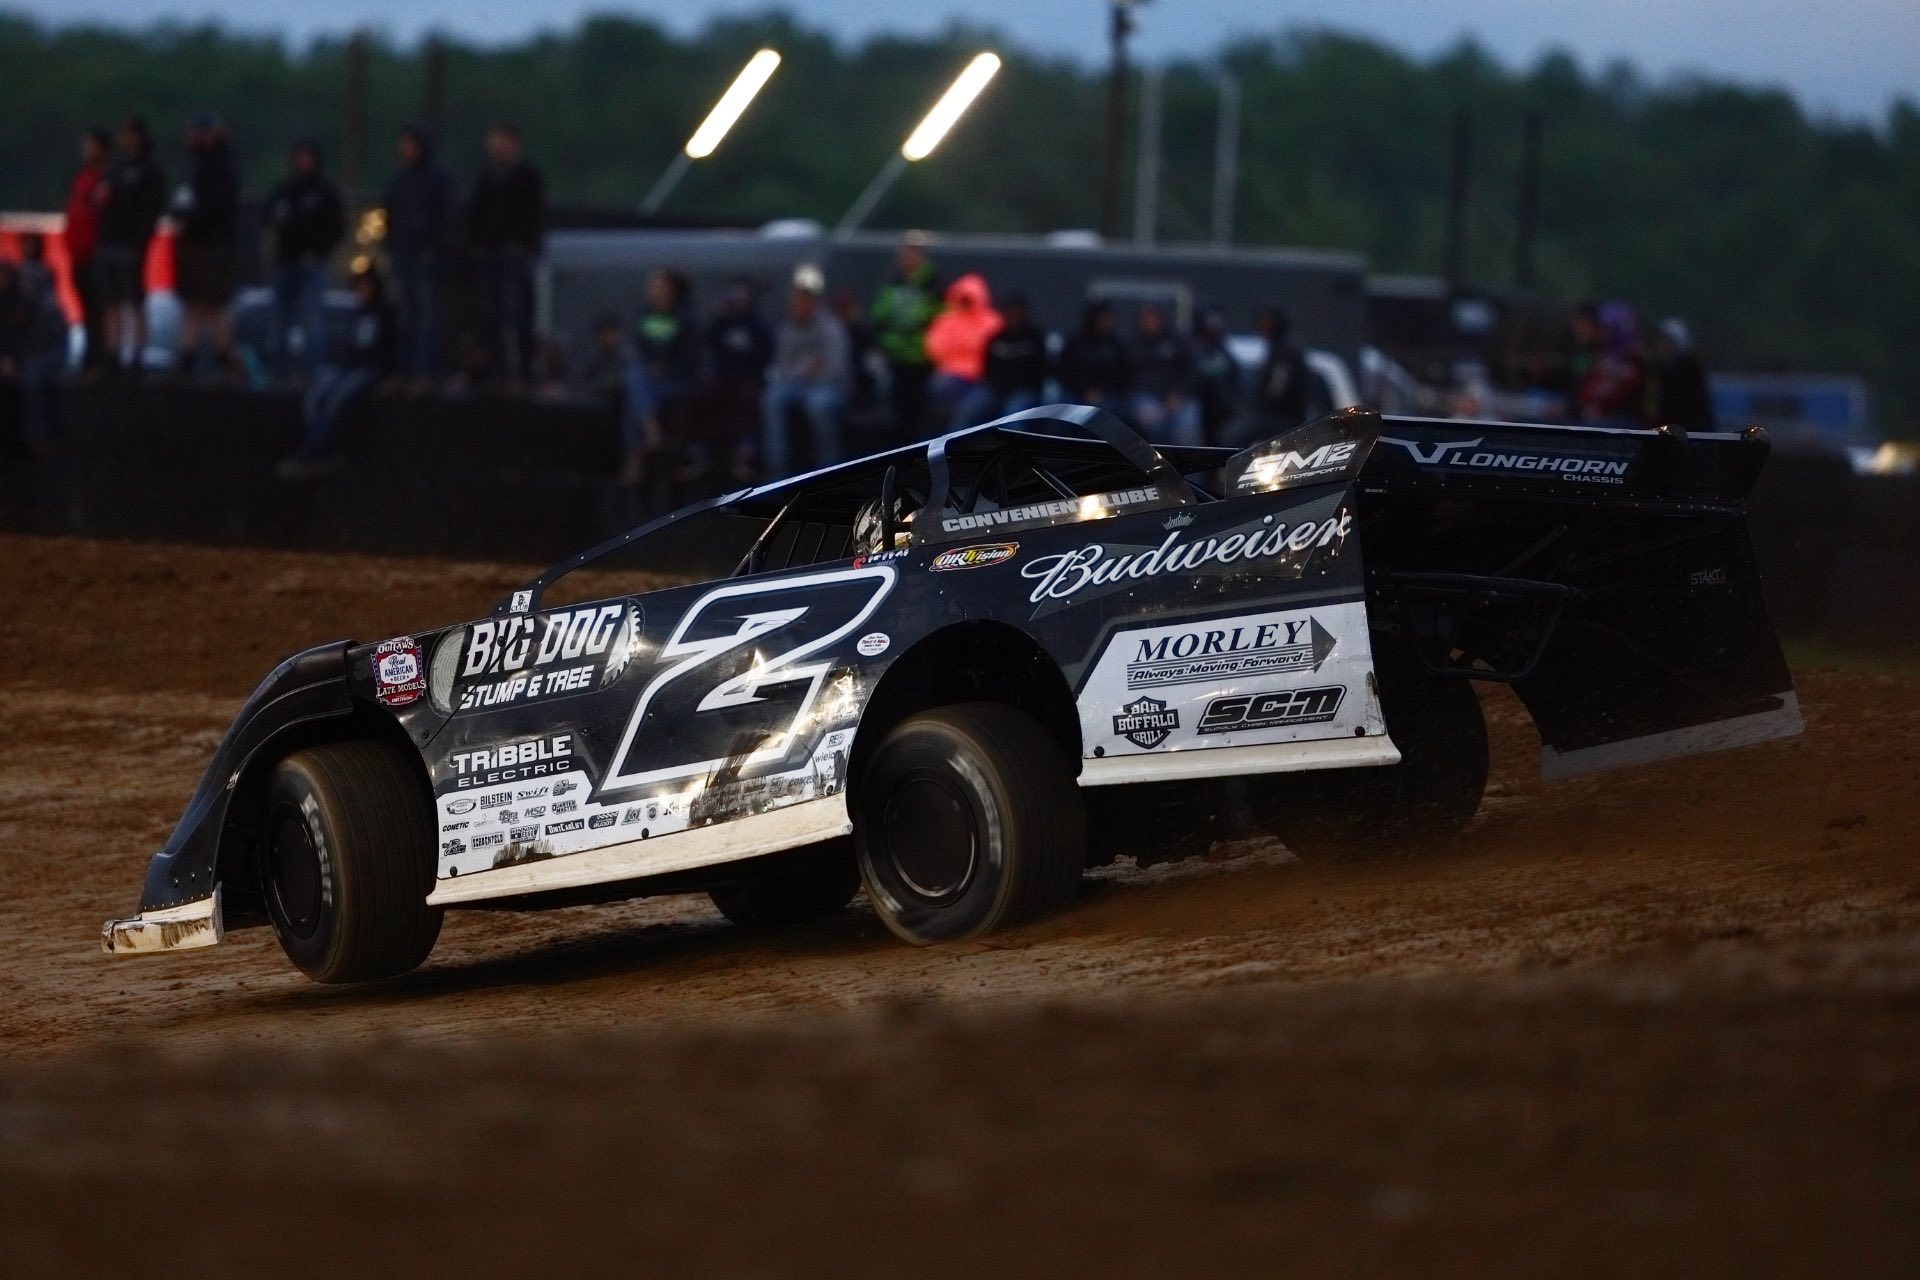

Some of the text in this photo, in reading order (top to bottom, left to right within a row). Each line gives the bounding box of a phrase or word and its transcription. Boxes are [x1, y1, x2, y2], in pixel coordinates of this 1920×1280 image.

[1450, 451, 1629, 475] LONGHORN
[1562, 473, 1624, 484] CHASSIS
[942, 487, 1160, 532] CONVENIEN LUBE
[1020, 514, 1352, 603] Budweiser
[378, 638, 415, 654] OUTLAWS
[461, 604, 622, 677] BIG DOG
[1133, 619, 1309, 663] MORLEY
[388, 654, 407, 668] Real
[1133, 652, 1304, 681] Always Moving Forward
[384, 664, 414, 678] AMERICAN
[600, 564, 898, 793] 2
[377, 679, 427, 697] LATE MODELS
[459, 664, 595, 710] STUMP & TREE
[1131, 701, 1162, 714] BAR
[1117, 712, 1176, 732] BUFFALO
[1240, 721, 1267, 729] CHAIN
[1132, 730, 1164, 746] GRILL
[453, 735, 572, 775] TRIBBLE
[457, 760, 571, 788] ELECTRIC
[480, 791, 513, 806] BILSTEIN
[516, 785, 550, 800] Swift
[524, 805, 547, 817] MSD
[442, 821, 470, 832] COMETIC
